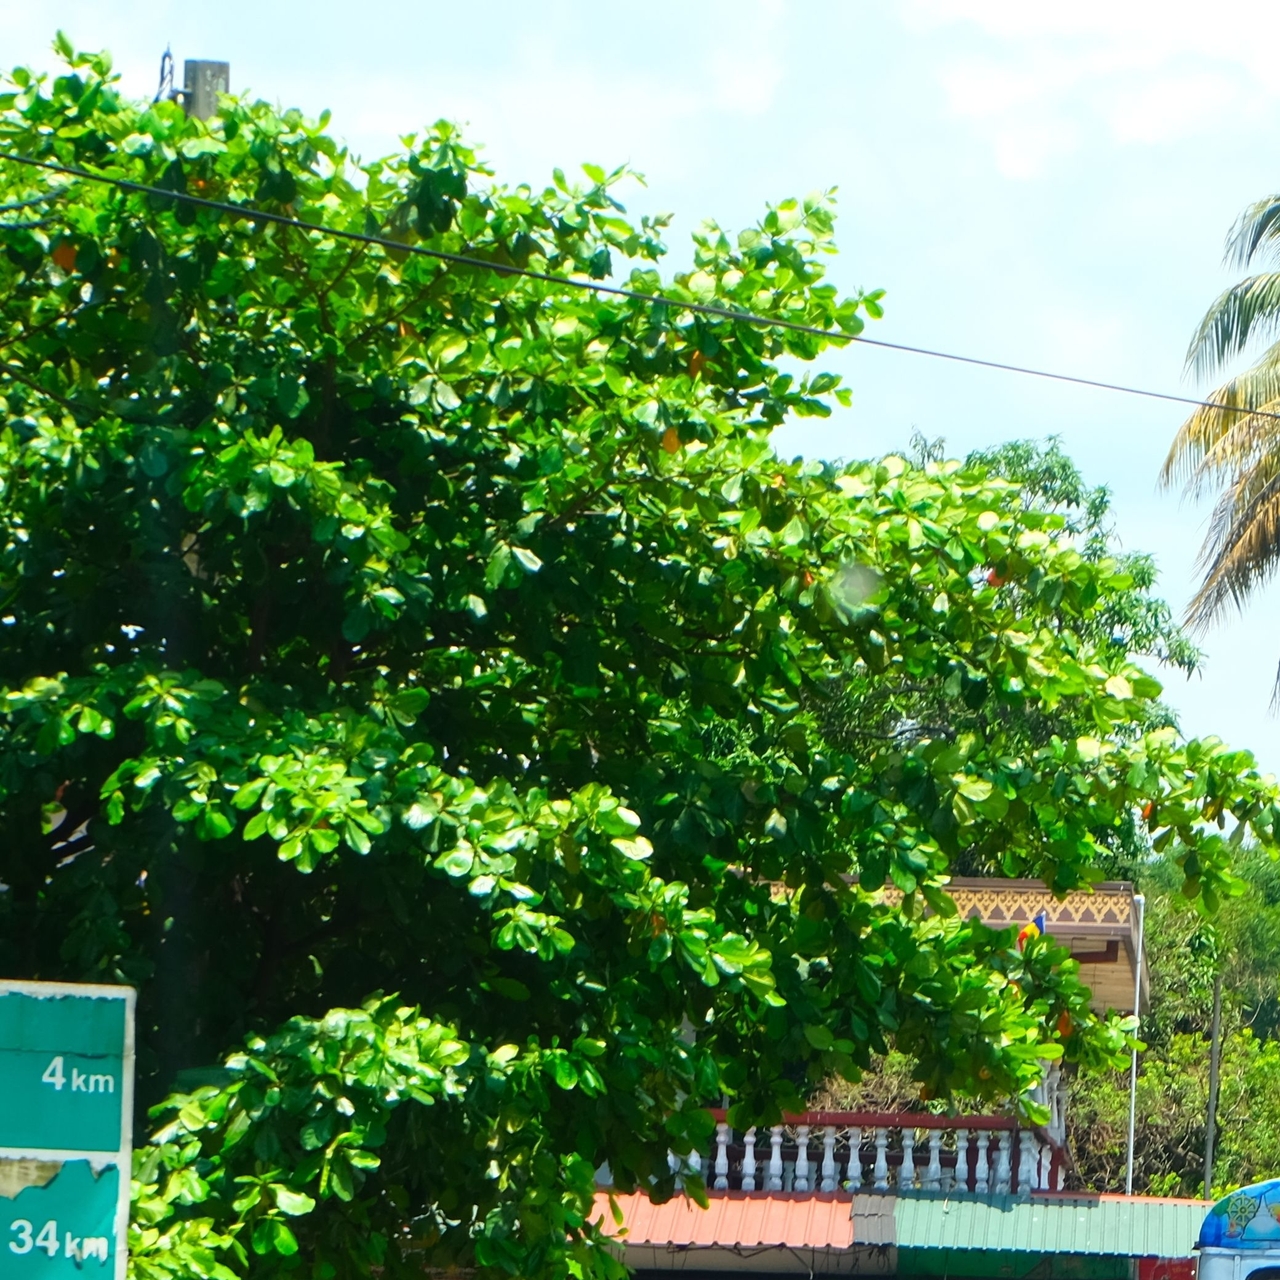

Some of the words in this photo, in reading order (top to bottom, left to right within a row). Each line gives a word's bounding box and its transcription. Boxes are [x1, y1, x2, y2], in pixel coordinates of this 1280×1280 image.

[42, 1055, 67, 1091] 4
[71, 1068, 115, 1093] km
[8, 1219, 60, 1257] 34
